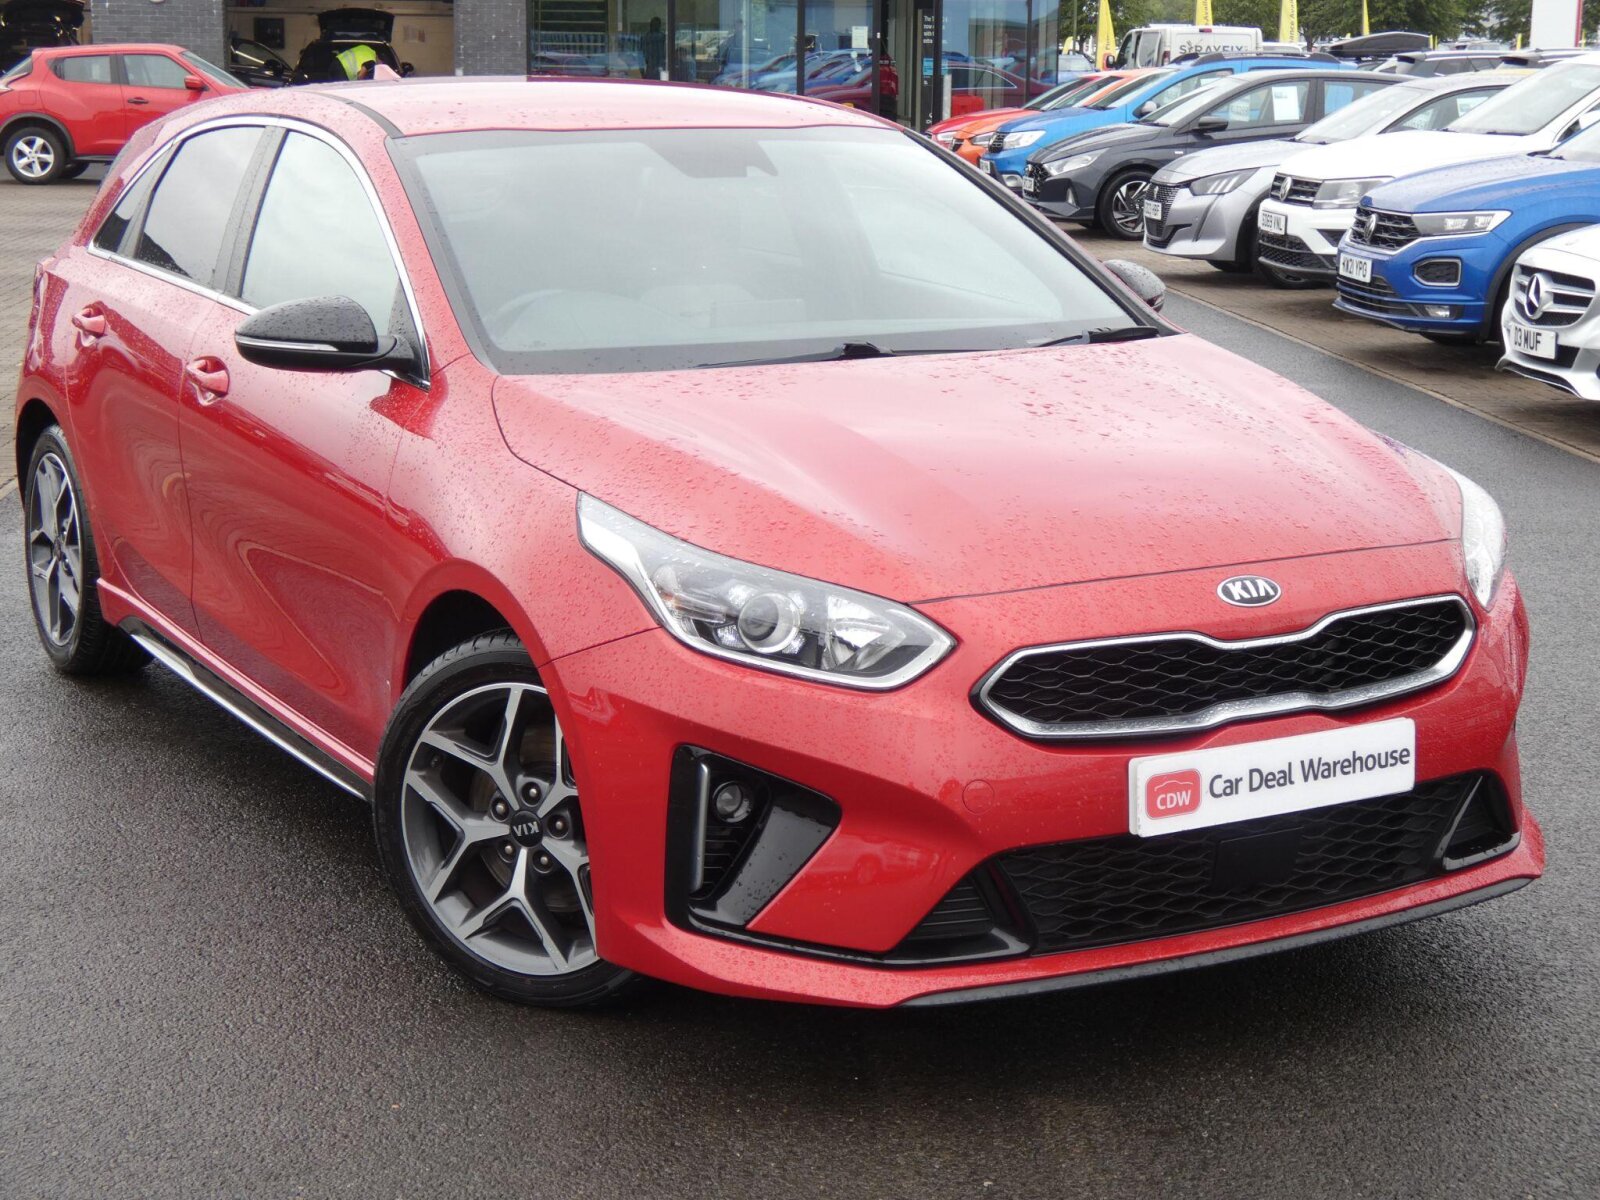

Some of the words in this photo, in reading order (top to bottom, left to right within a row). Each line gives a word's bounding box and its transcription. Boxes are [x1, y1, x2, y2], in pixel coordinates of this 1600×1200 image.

[1523, 328, 1542, 351] MUF
[1226, 579, 1276, 600] KIA
[1209, 773, 1243, 799] Car
[1249, 762, 1295, 793] Deal
[1300, 747, 1411, 783] Warehouse
[1156, 789, 1192, 810] CDW
[512, 821, 540, 837] KIA
